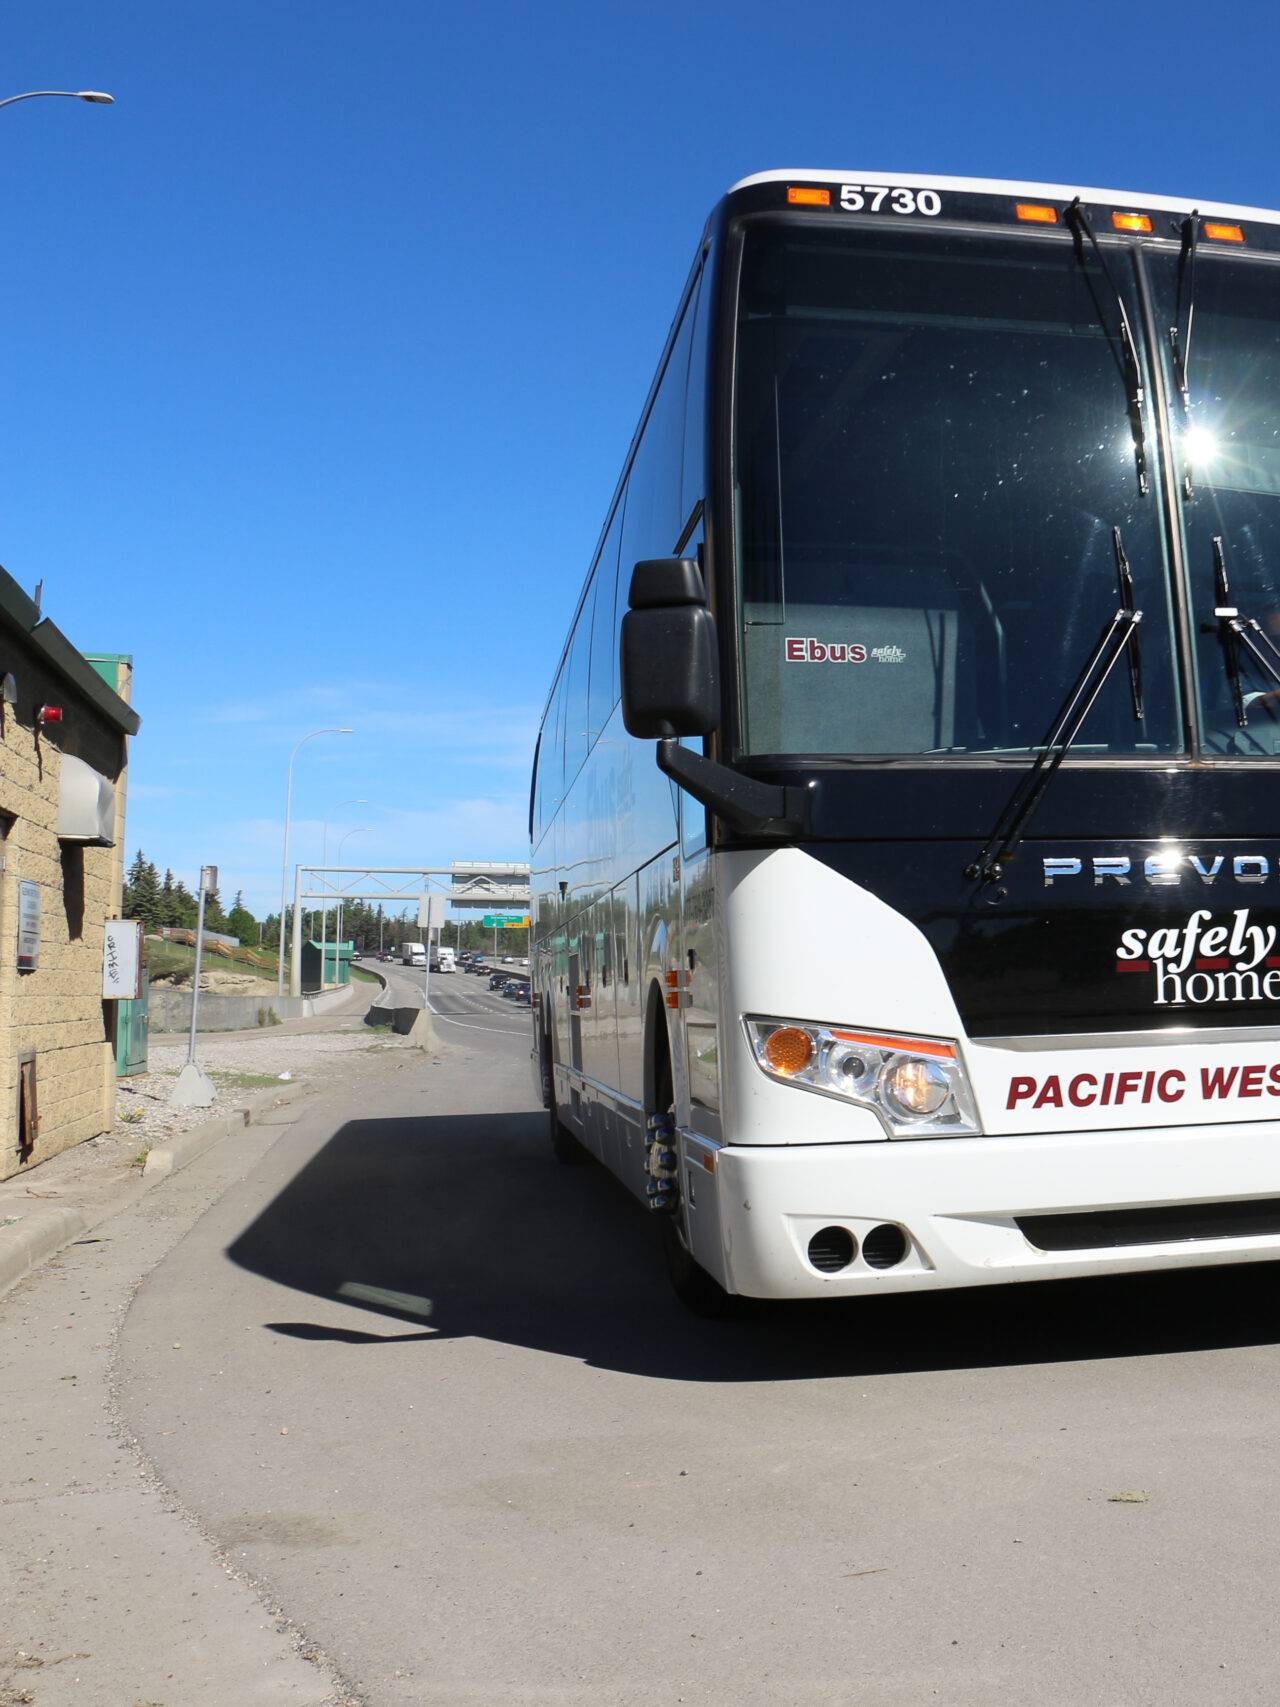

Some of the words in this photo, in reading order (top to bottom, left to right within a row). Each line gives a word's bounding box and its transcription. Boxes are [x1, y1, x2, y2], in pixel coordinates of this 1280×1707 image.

[840, 184, 942, 216] 5730
[785, 638, 867, 663] Ebus
[1116, 908, 1277, 973] safely
[1006, 1069, 1186, 1110] PACIFIC
